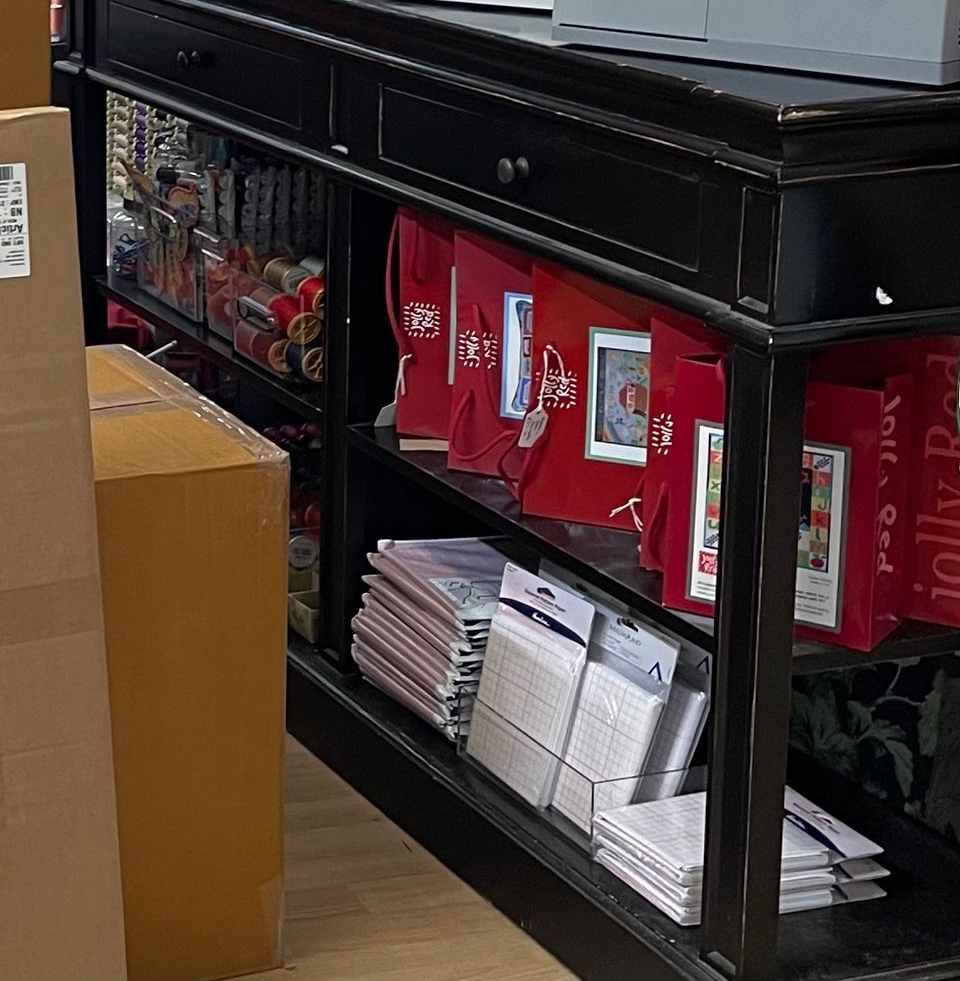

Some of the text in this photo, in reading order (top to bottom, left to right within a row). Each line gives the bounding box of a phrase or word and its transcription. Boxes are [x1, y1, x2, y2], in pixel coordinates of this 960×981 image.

[10, 207, 23, 216] NB
[410, 308, 426, 332] Jolly
[421, 309, 435, 328] Red
[465, 336, 481, 362] Jolly
[543, 375, 560, 402] Jolly
[555, 375, 571, 397] Red
